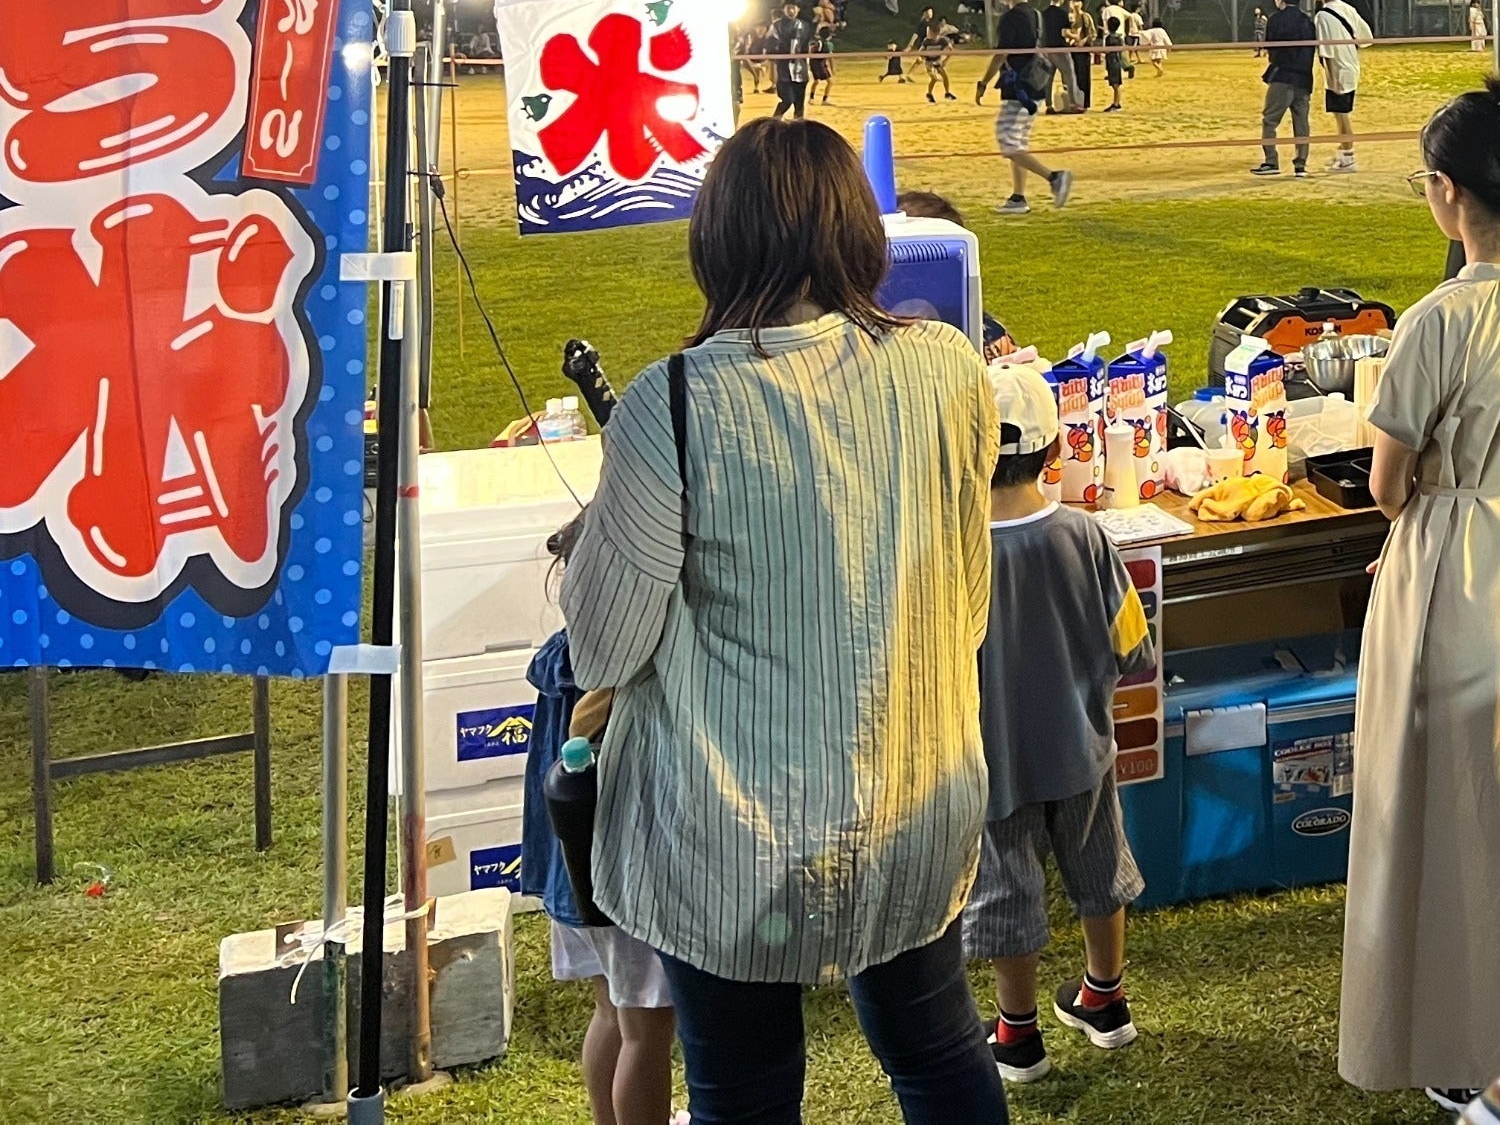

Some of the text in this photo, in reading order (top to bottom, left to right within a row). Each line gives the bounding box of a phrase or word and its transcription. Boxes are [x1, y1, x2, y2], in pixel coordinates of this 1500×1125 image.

[460, 723, 493, 738] ヤマフク
[501, 725, 529, 746] 福
[1295, 813, 1347, 829] COLORADO
[473, 861, 506, 876] ヤマフク
